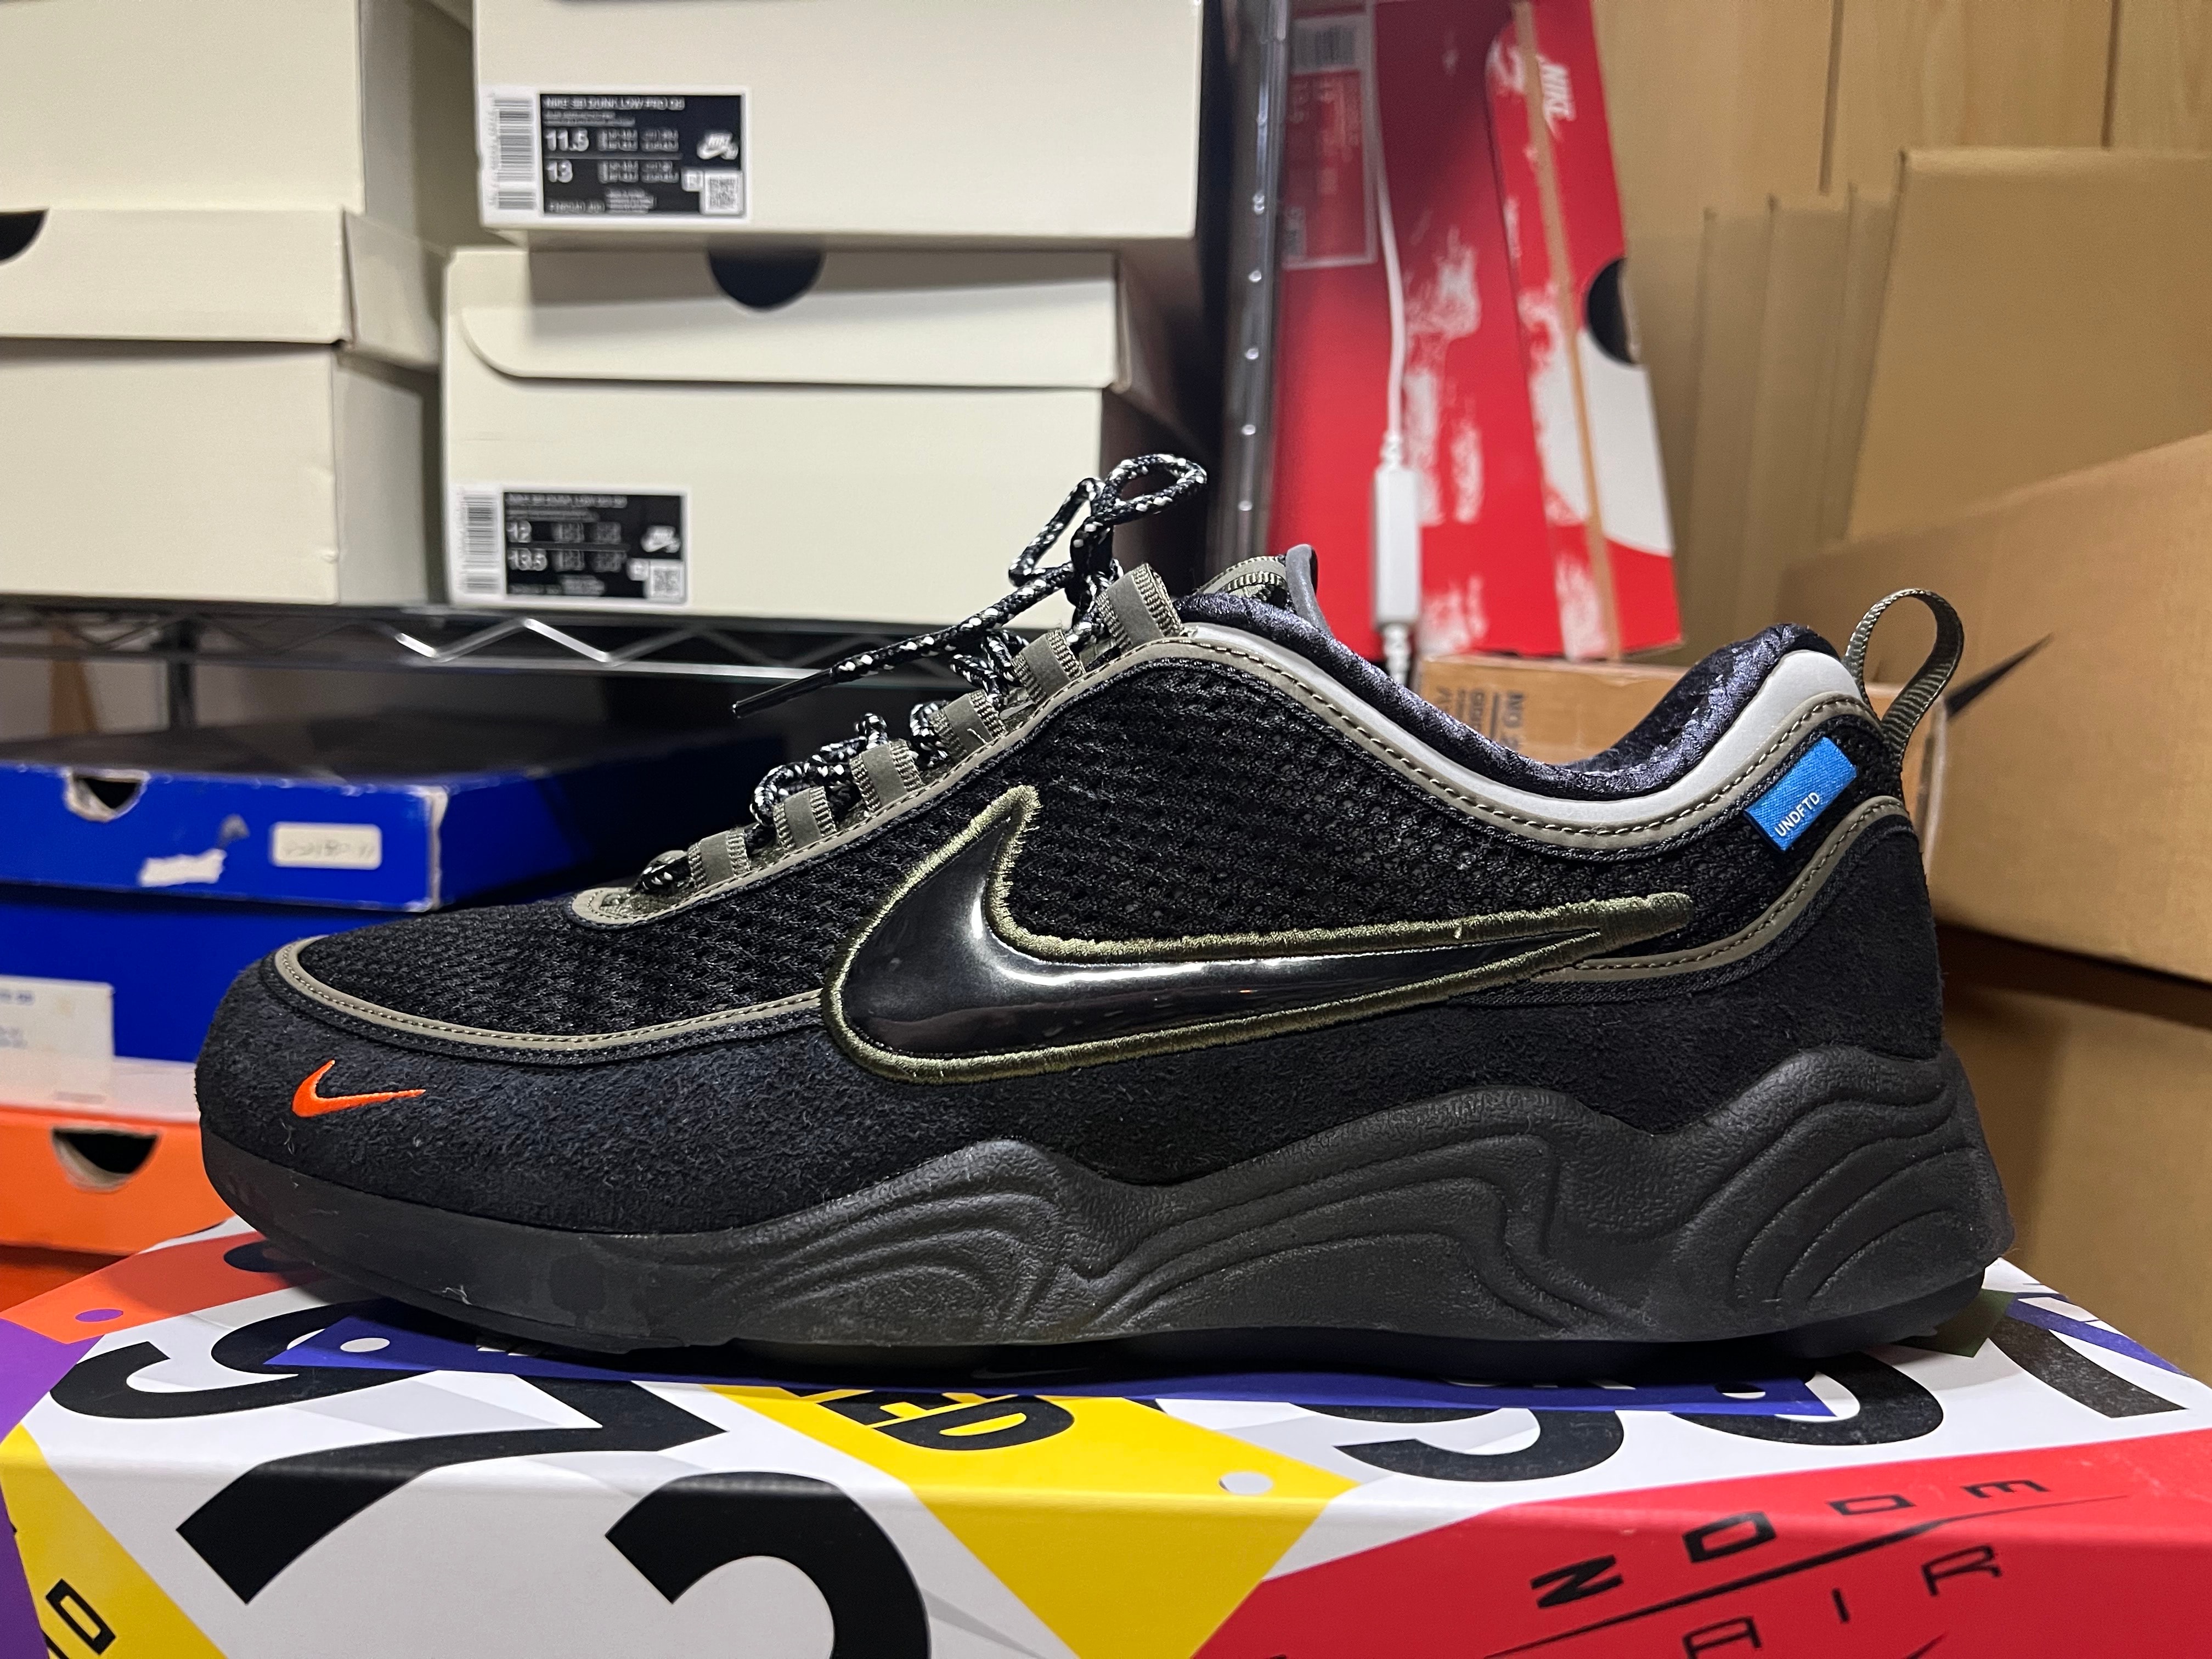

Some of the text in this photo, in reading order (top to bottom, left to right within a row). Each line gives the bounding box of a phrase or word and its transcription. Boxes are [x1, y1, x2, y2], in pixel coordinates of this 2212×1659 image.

[545, 128, 589, 151] 11.5
[546, 160, 573, 183] 13
[1774, 792, 1820, 837] UNDFTD
